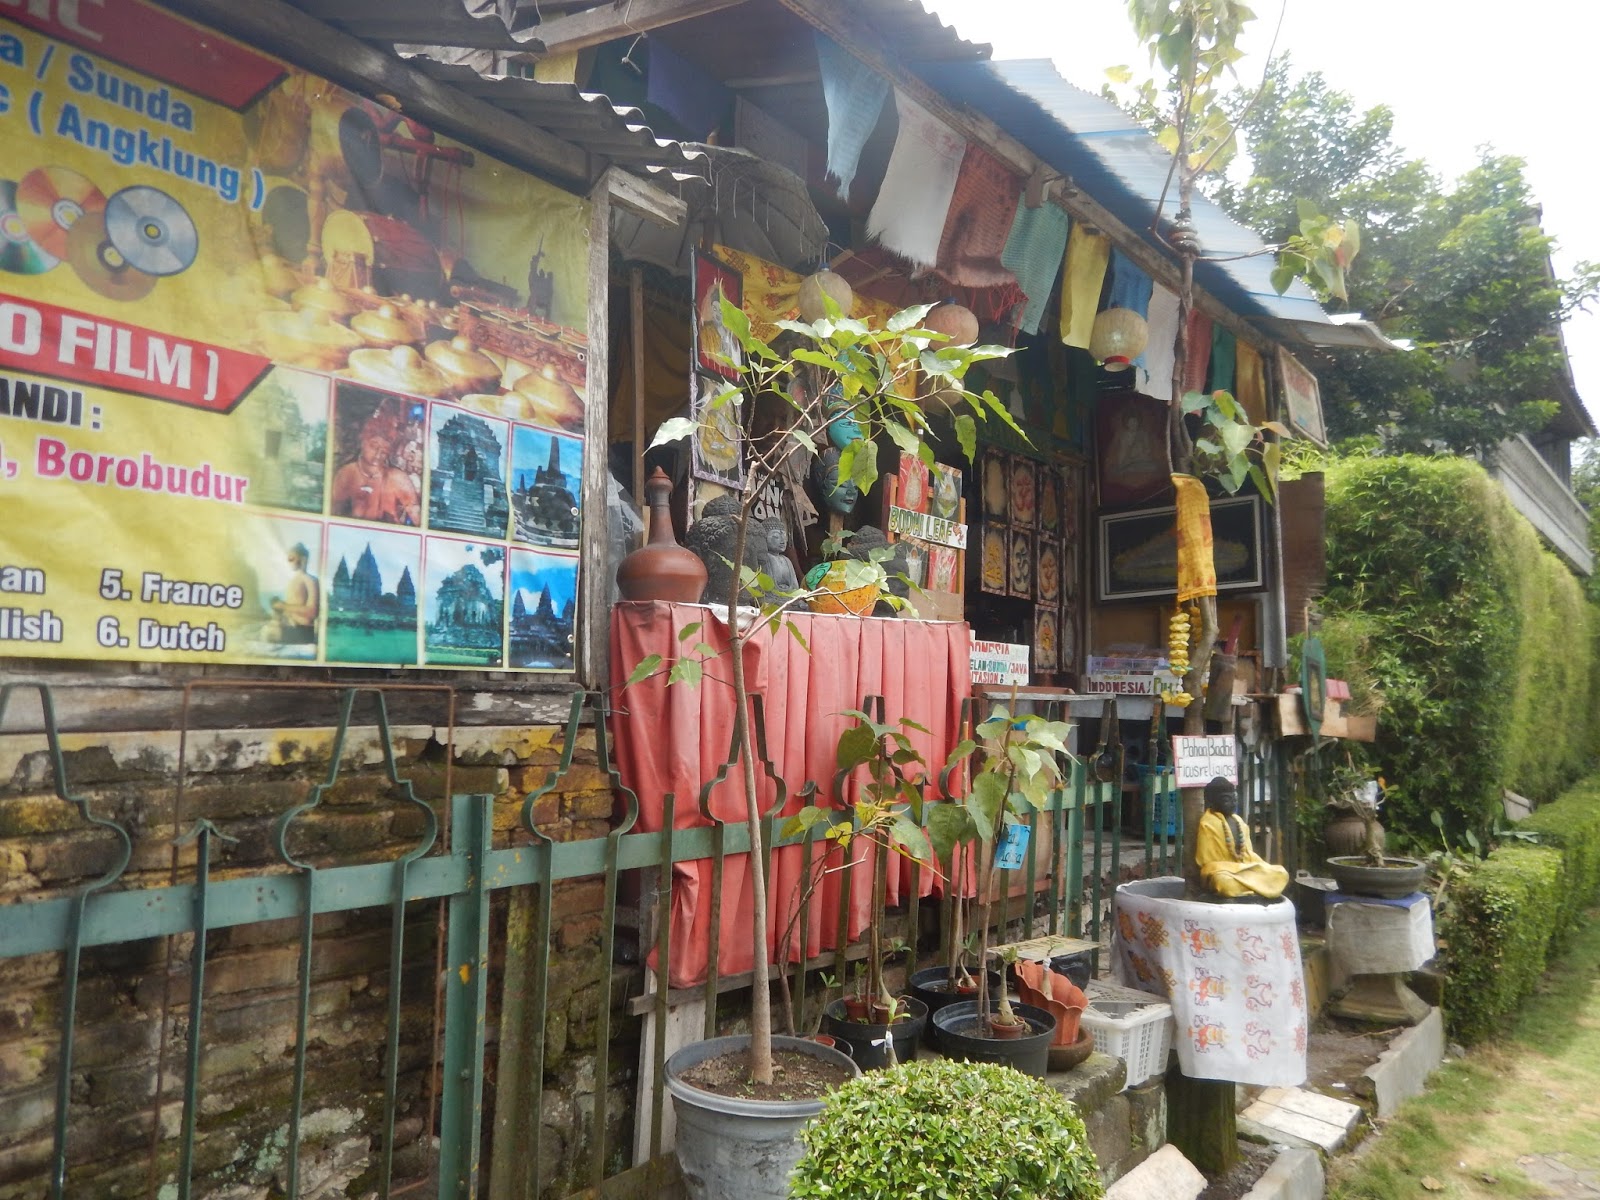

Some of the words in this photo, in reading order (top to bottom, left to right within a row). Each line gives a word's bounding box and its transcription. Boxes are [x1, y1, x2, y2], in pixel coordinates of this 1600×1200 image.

[68, 54, 193, 131] Sunda
[58, 314, 192, 390] FILM
[38, 437, 247, 502] Borobudur
[926, 516, 953, 544] LEAF
[100, 568, 131, 600] 5.
[140, 572, 243, 608] France
[97, 616, 128, 647] 6.
[138, 619, 226, 652] Dutch
